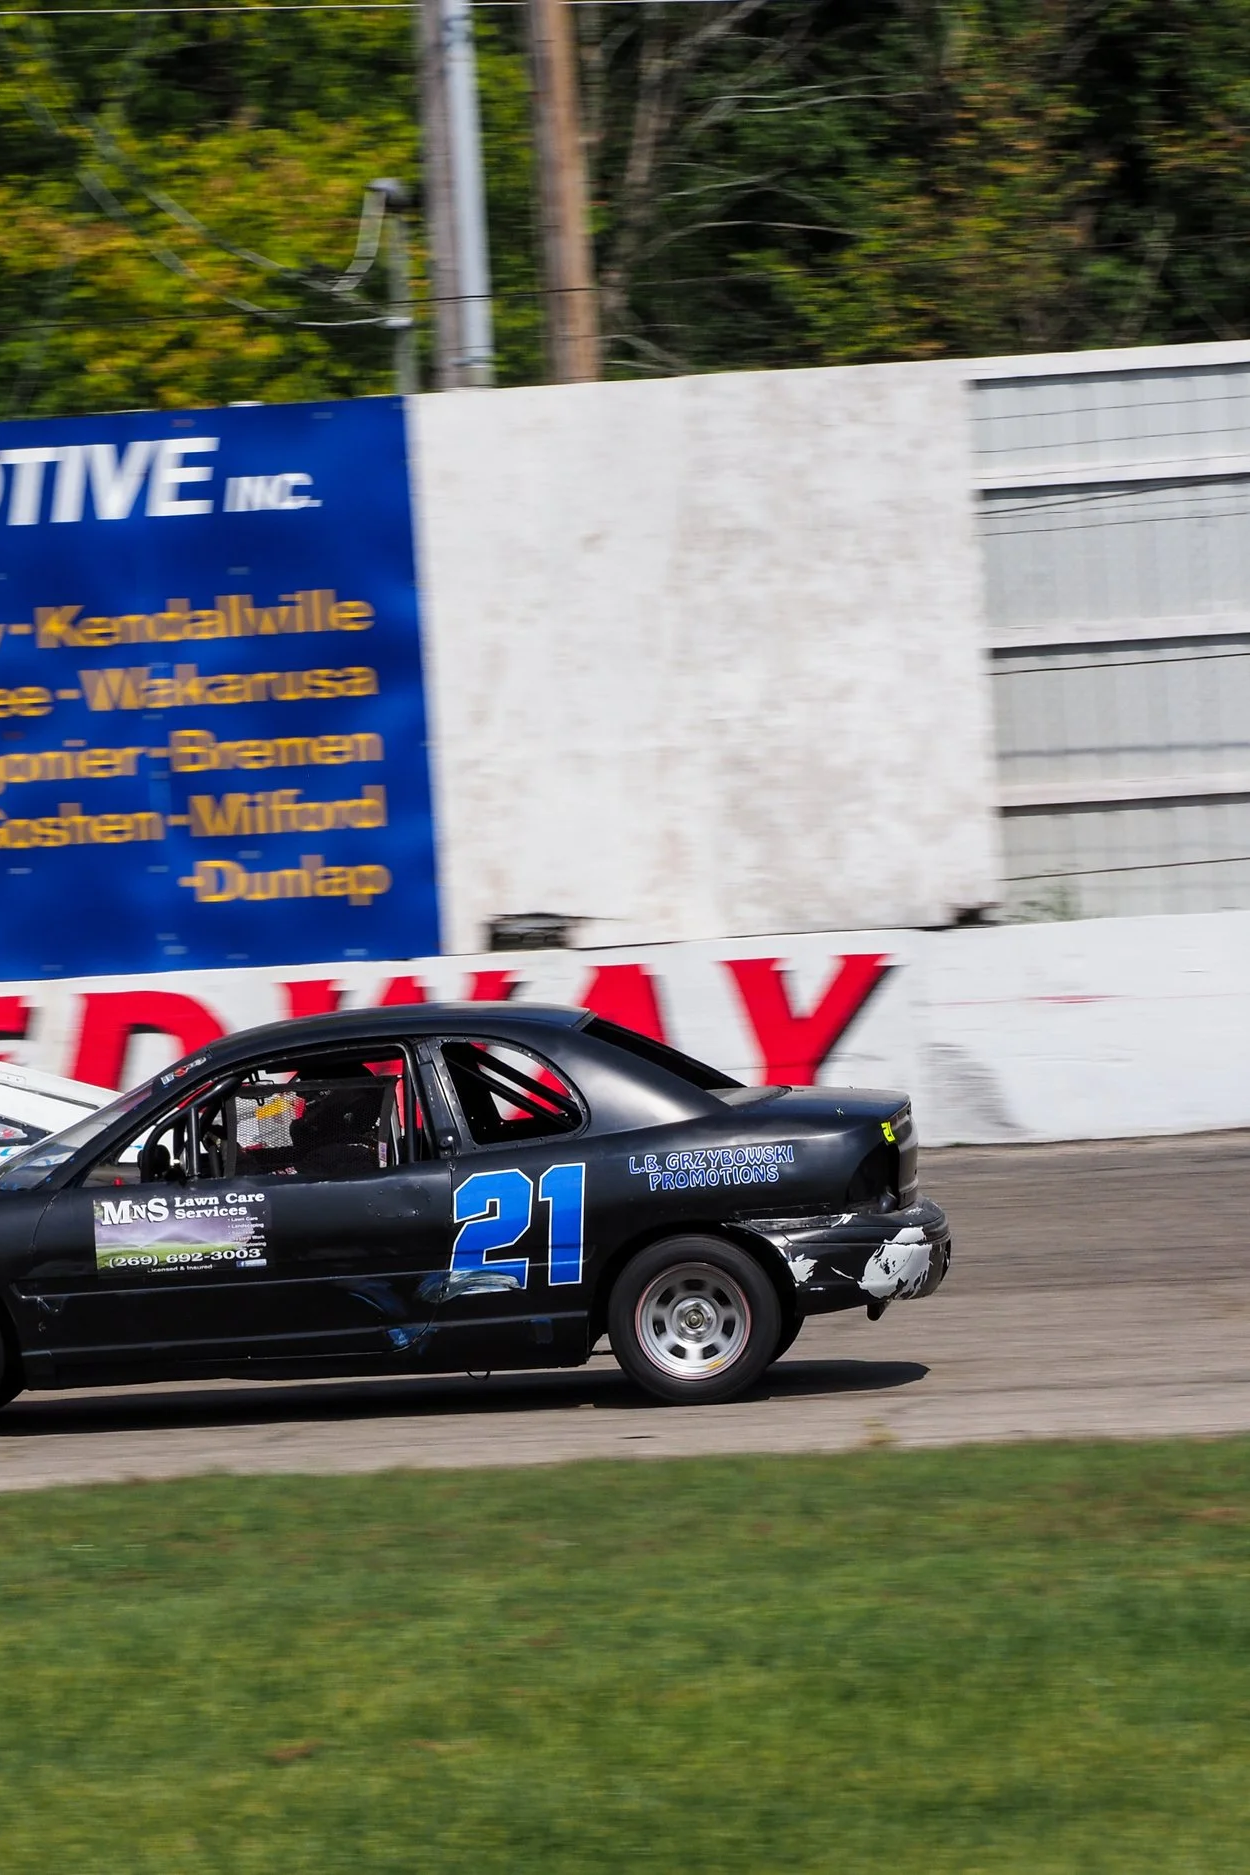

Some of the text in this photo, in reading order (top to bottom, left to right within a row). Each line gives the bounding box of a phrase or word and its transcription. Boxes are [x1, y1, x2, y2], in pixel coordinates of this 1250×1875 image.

[222, 473, 323, 512] INC.
[628, 1145, 795, 1175] L.B. GRZYBOWSKI
[649, 1164, 780, 1191] PROMOTIONS
[174, 1196, 220, 1208] Lawn
[225, 1192, 266, 1205] Care
[174, 1205, 248, 1220] Services
[451, 1162, 586, 1290] 21
[109, 1254, 159, 1269] (269)
[166, 1247, 262, 1265] 692-3003
